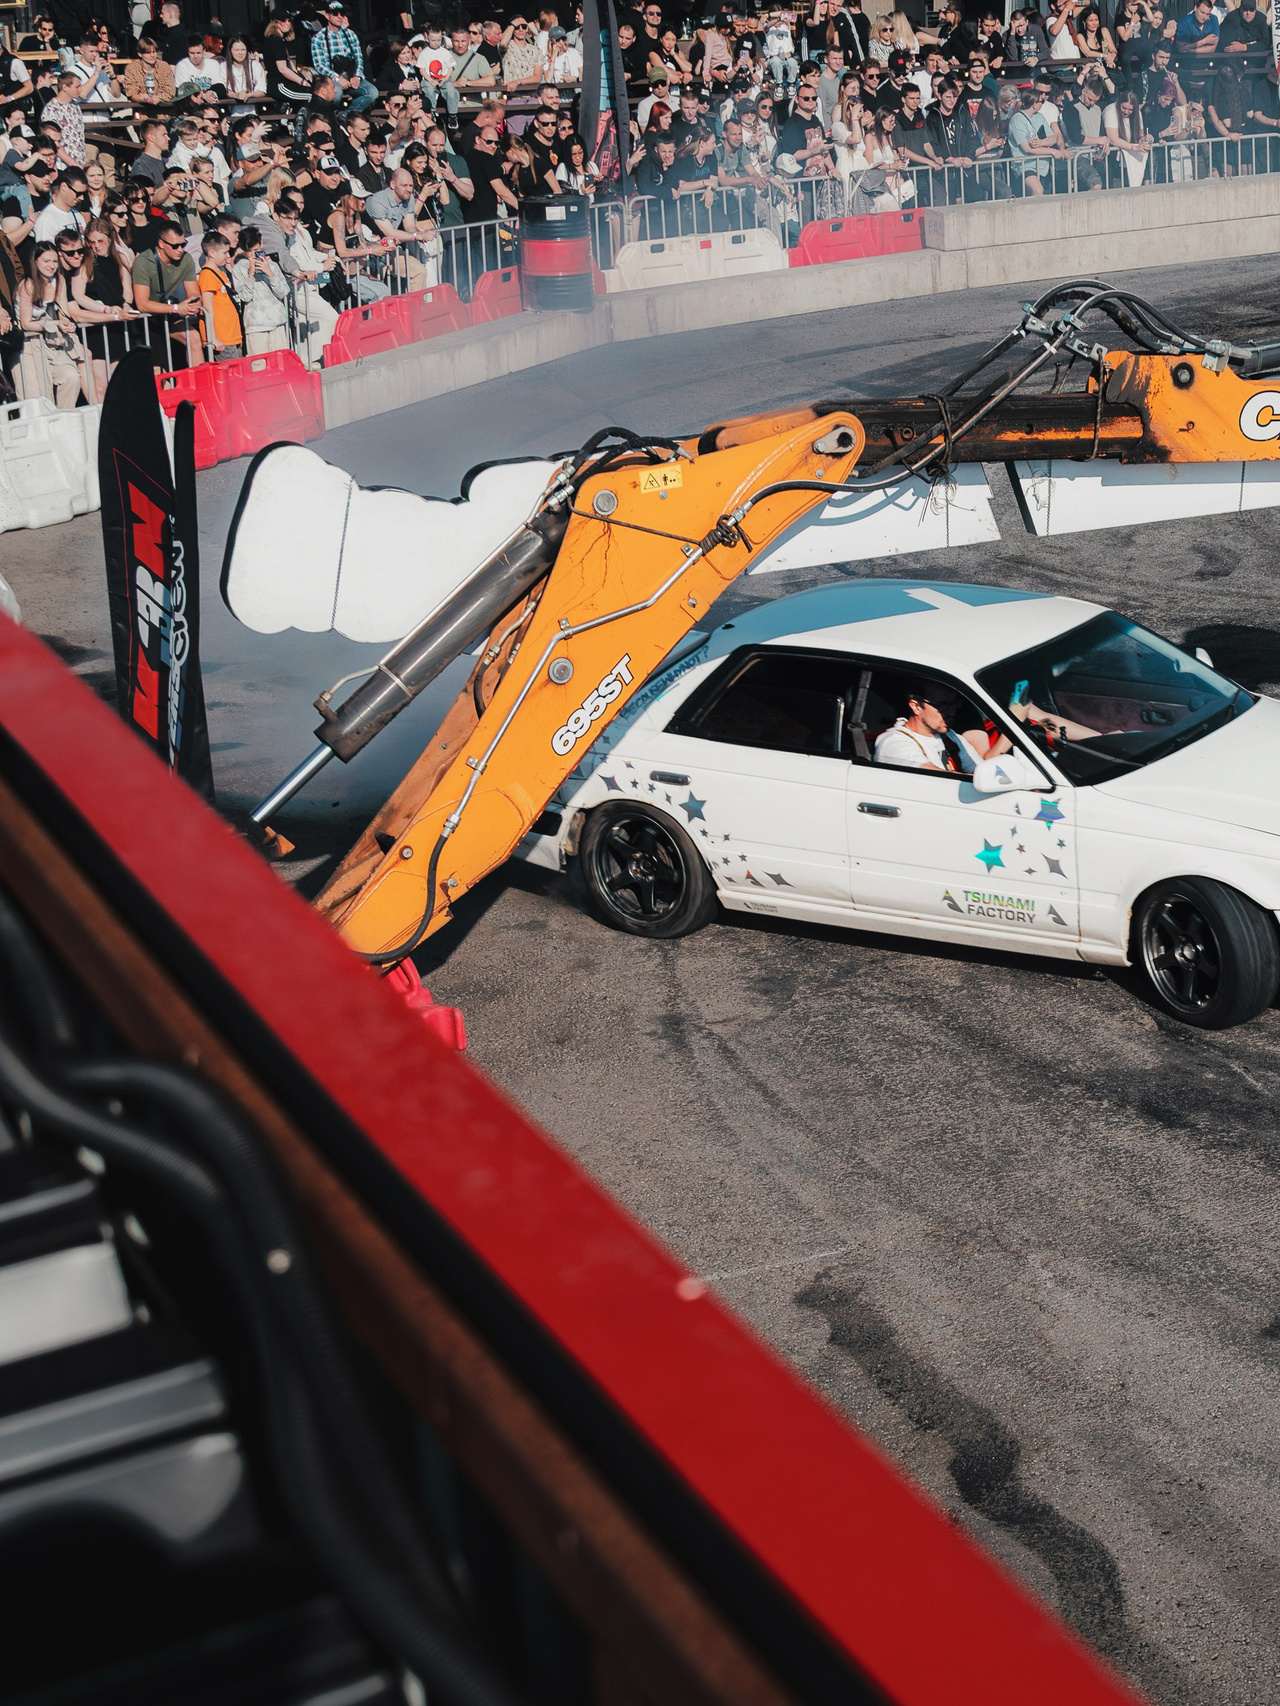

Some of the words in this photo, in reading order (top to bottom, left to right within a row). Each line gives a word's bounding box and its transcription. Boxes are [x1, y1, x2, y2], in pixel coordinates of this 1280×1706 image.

[551, 652, 634, 756] 695ST
[963, 890, 1035, 911] TSUNAMI
[968, 904, 1036, 923] FACTORY
